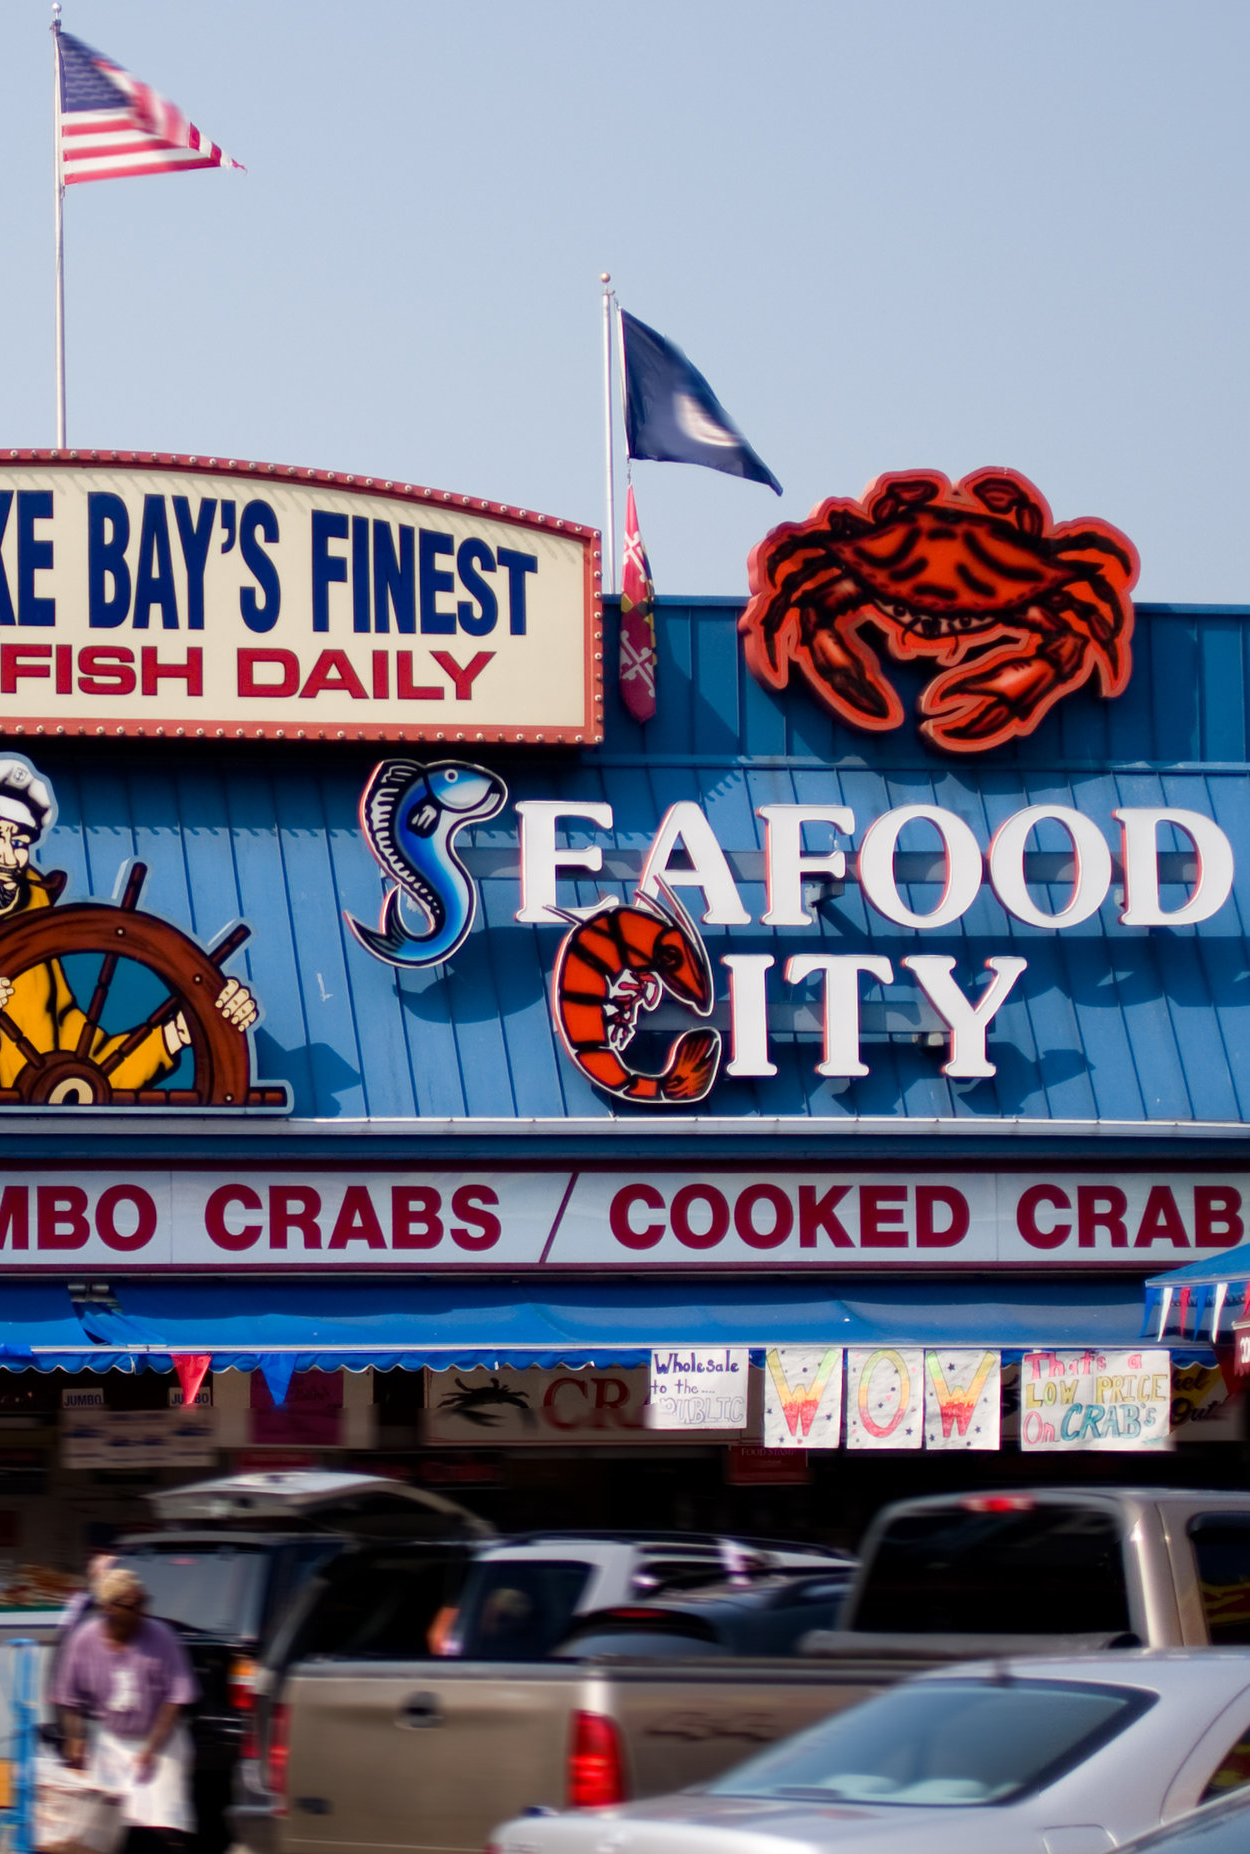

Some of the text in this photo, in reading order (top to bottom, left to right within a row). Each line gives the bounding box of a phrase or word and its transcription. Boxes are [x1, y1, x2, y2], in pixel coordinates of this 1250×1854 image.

[88, 491, 281, 633] BAY'S
[311, 509, 538, 636] FINEST
[0, 641, 205, 698] FISH
[236, 647, 496, 701] DAILY
[203, 1182, 503, 1252] CRABS
[608, 1182, 971, 1251] COOKED
[1015, 1182, 1245, 1250] CRAB
[654, 1350, 740, 1375] Wholesale
[1024, 1351, 1143, 1380] That's a
[64, 1394, 103, 1406] JUMBO
[171, 1393, 210, 1404] JUBO
[650, 1379, 667, 1394] to
[1025, 1374, 1168, 1408] LOW PRICE
